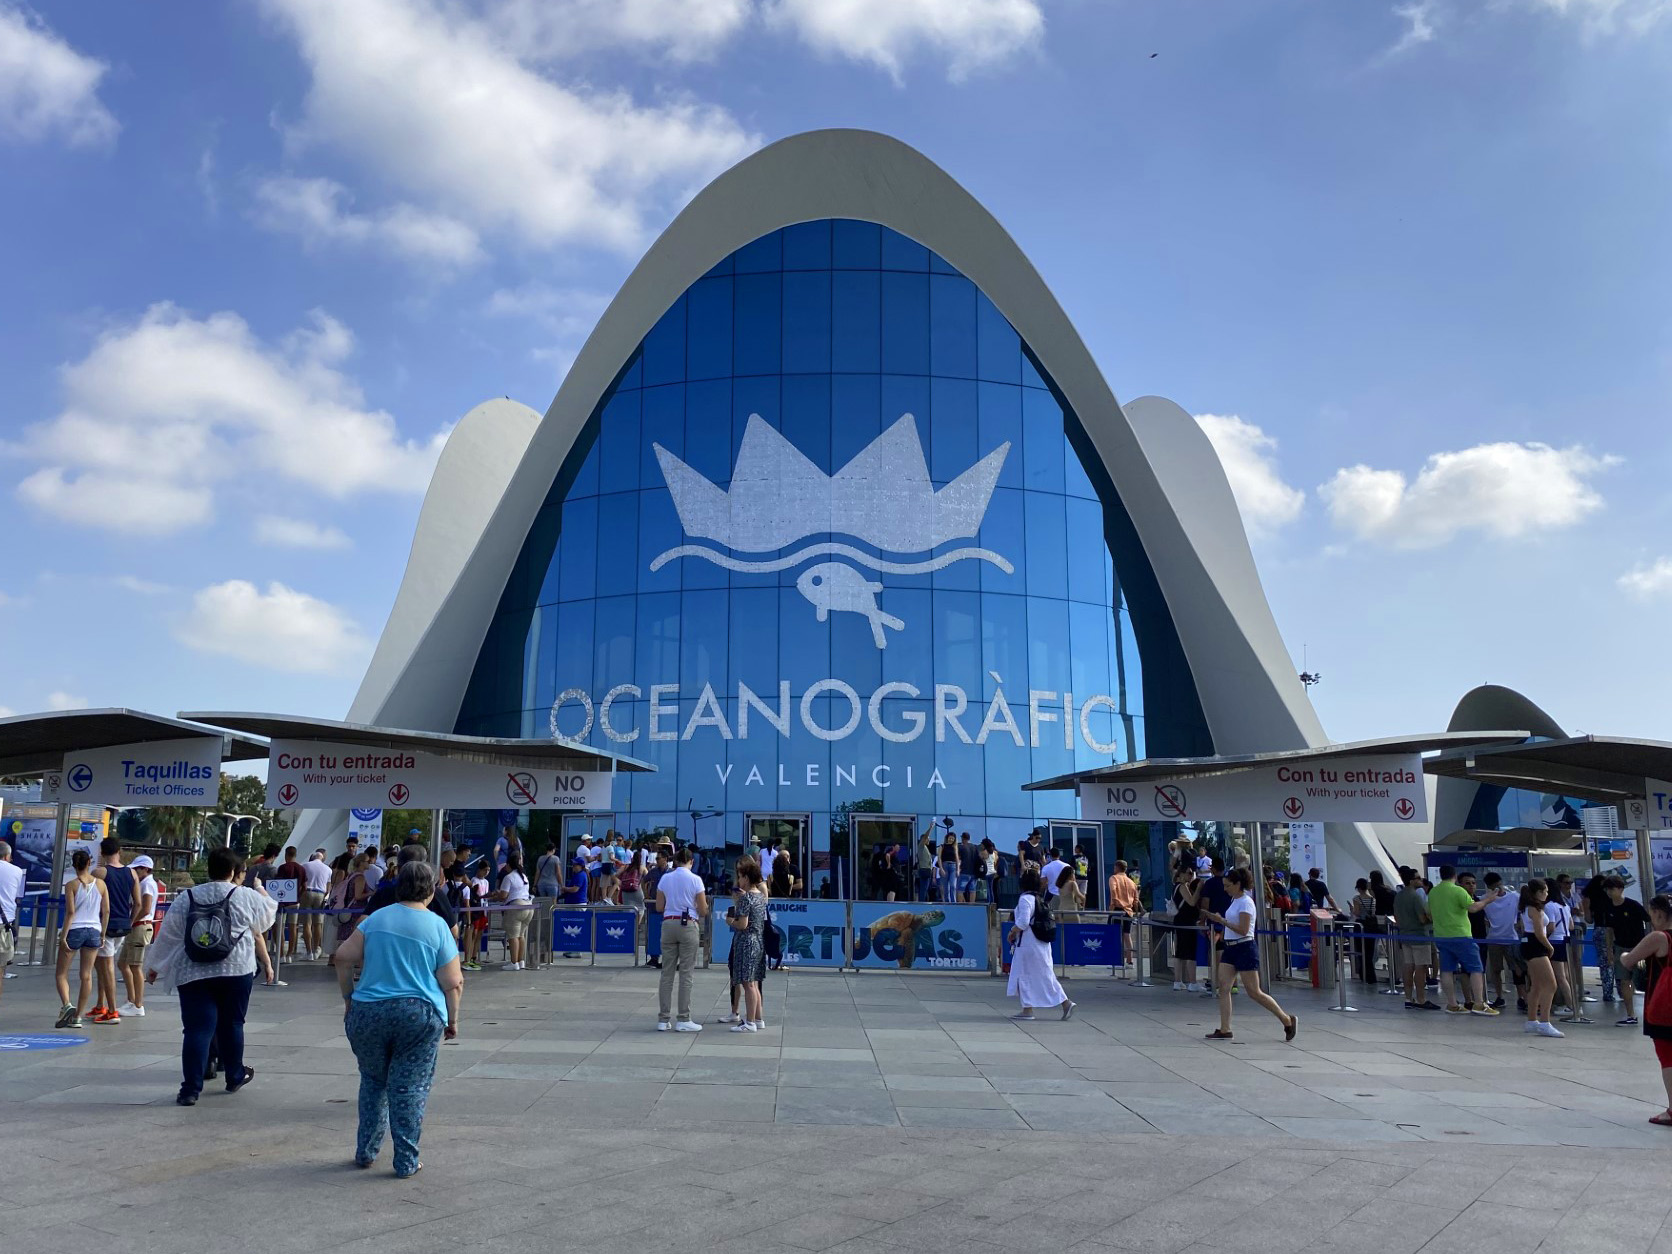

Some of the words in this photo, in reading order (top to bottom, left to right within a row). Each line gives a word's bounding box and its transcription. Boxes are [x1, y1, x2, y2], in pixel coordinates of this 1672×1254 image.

[550, 670, 1118, 754] OCEANOGRÀFIC
[278, 753, 312, 769] Con
[319, 753, 337, 769] tu
[343, 753, 415, 769] entrada
[121, 761, 212, 782] Taquillas
[715, 763, 947, 790] VALENCIA
[1277, 767, 1313, 782] Con
[1320, 768, 1337, 783] tu
[1344, 768, 1415, 784] entrada
[303, 774, 326, 784] With
[330, 775, 353, 785] your
[356, 774, 386, 784] ticket
[555, 775, 585, 791] NO
[125, 784, 160, 795] Ticket
[163, 785, 205, 796] Offices
[1107, 787, 1137, 804] NO
[1306, 787, 1330, 797] With
[1333, 790, 1356, 799] your
[1359, 788, 1390, 797] ticket
[553, 796, 586, 805] PICNIC
[1106, 808, 1139, 817] PICNIC
[20, 832, 51, 840] SHARK
[928, 957, 977, 968] TORTUES
